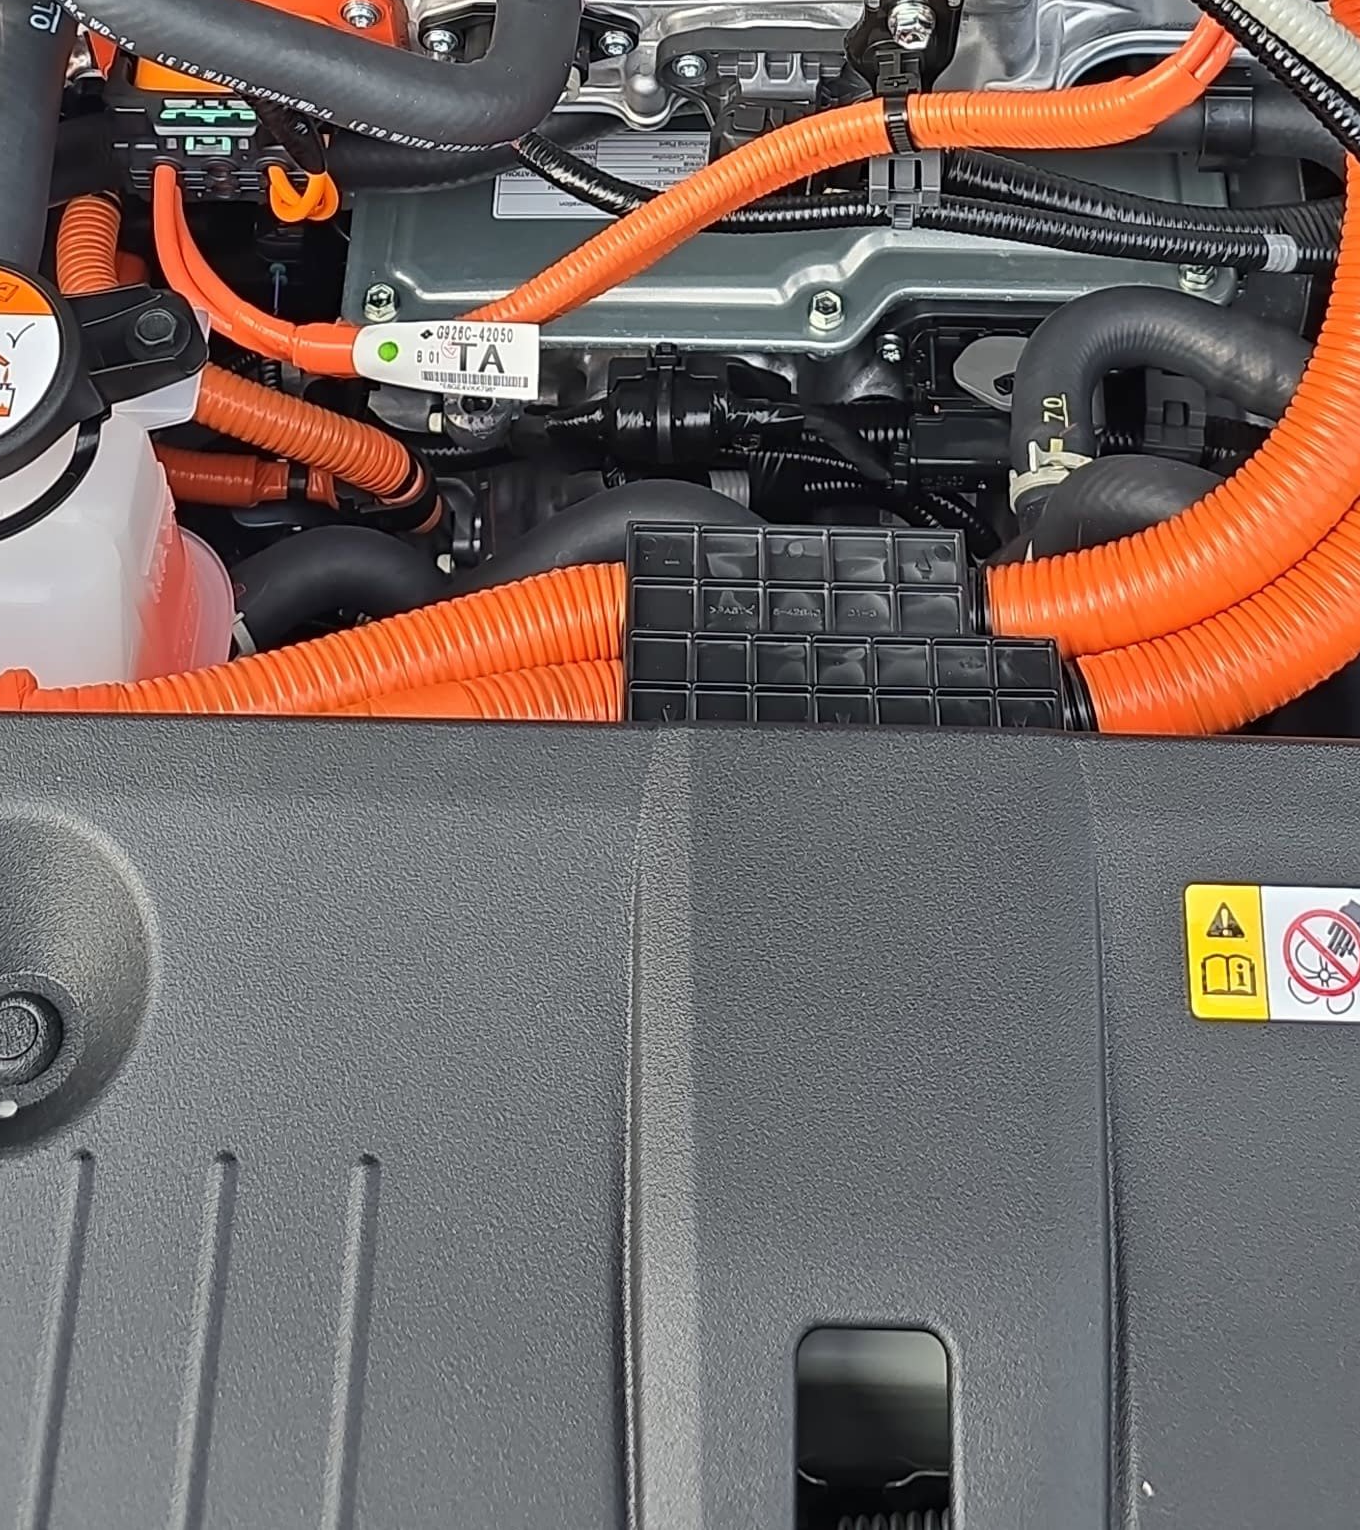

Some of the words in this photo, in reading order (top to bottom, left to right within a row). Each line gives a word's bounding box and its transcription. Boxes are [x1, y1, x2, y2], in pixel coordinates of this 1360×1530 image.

[201, 69, 247, 91] WATER
[390, 132, 435, 149] WATER
[437, 326, 513, 343] G926C-42050
[451, 342, 505, 374] TA
[1043, 397, 1064, 422] 70
